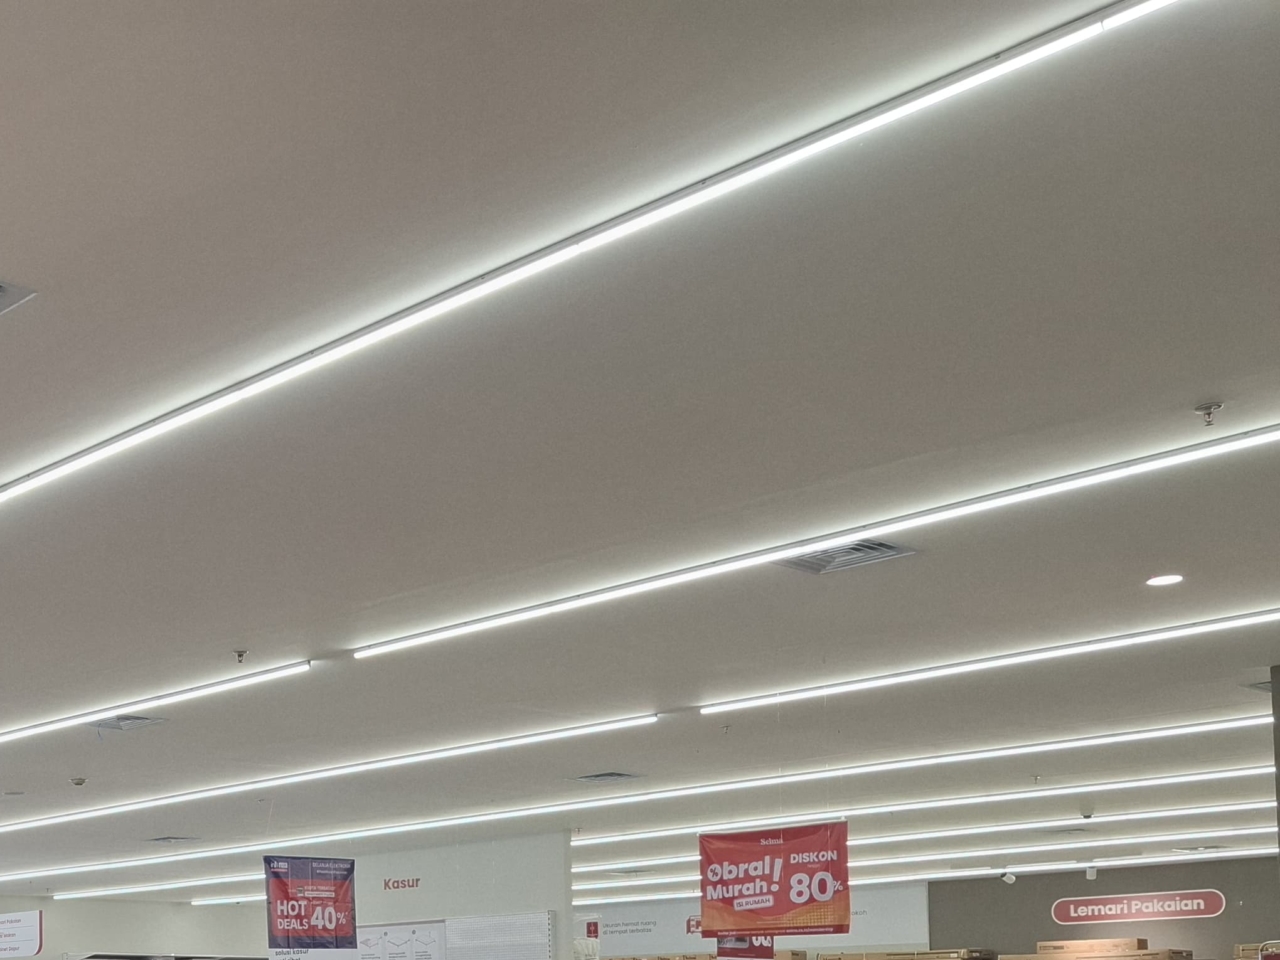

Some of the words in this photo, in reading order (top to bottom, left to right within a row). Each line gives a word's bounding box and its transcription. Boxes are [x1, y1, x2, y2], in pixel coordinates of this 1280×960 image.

[760, 837, 784, 846] Selma
[790, 850, 838, 864] DISKON
[706, 855, 770, 882] Obral
[383, 877, 421, 890] Kasur
[276, 899, 308, 916] HOT
[744, 898, 771, 907] RUMAH
[1069, 900, 1128, 918] Lemari
[1130, 896, 1205, 914] Pakaian
[277, 918, 309, 930] DEALS
